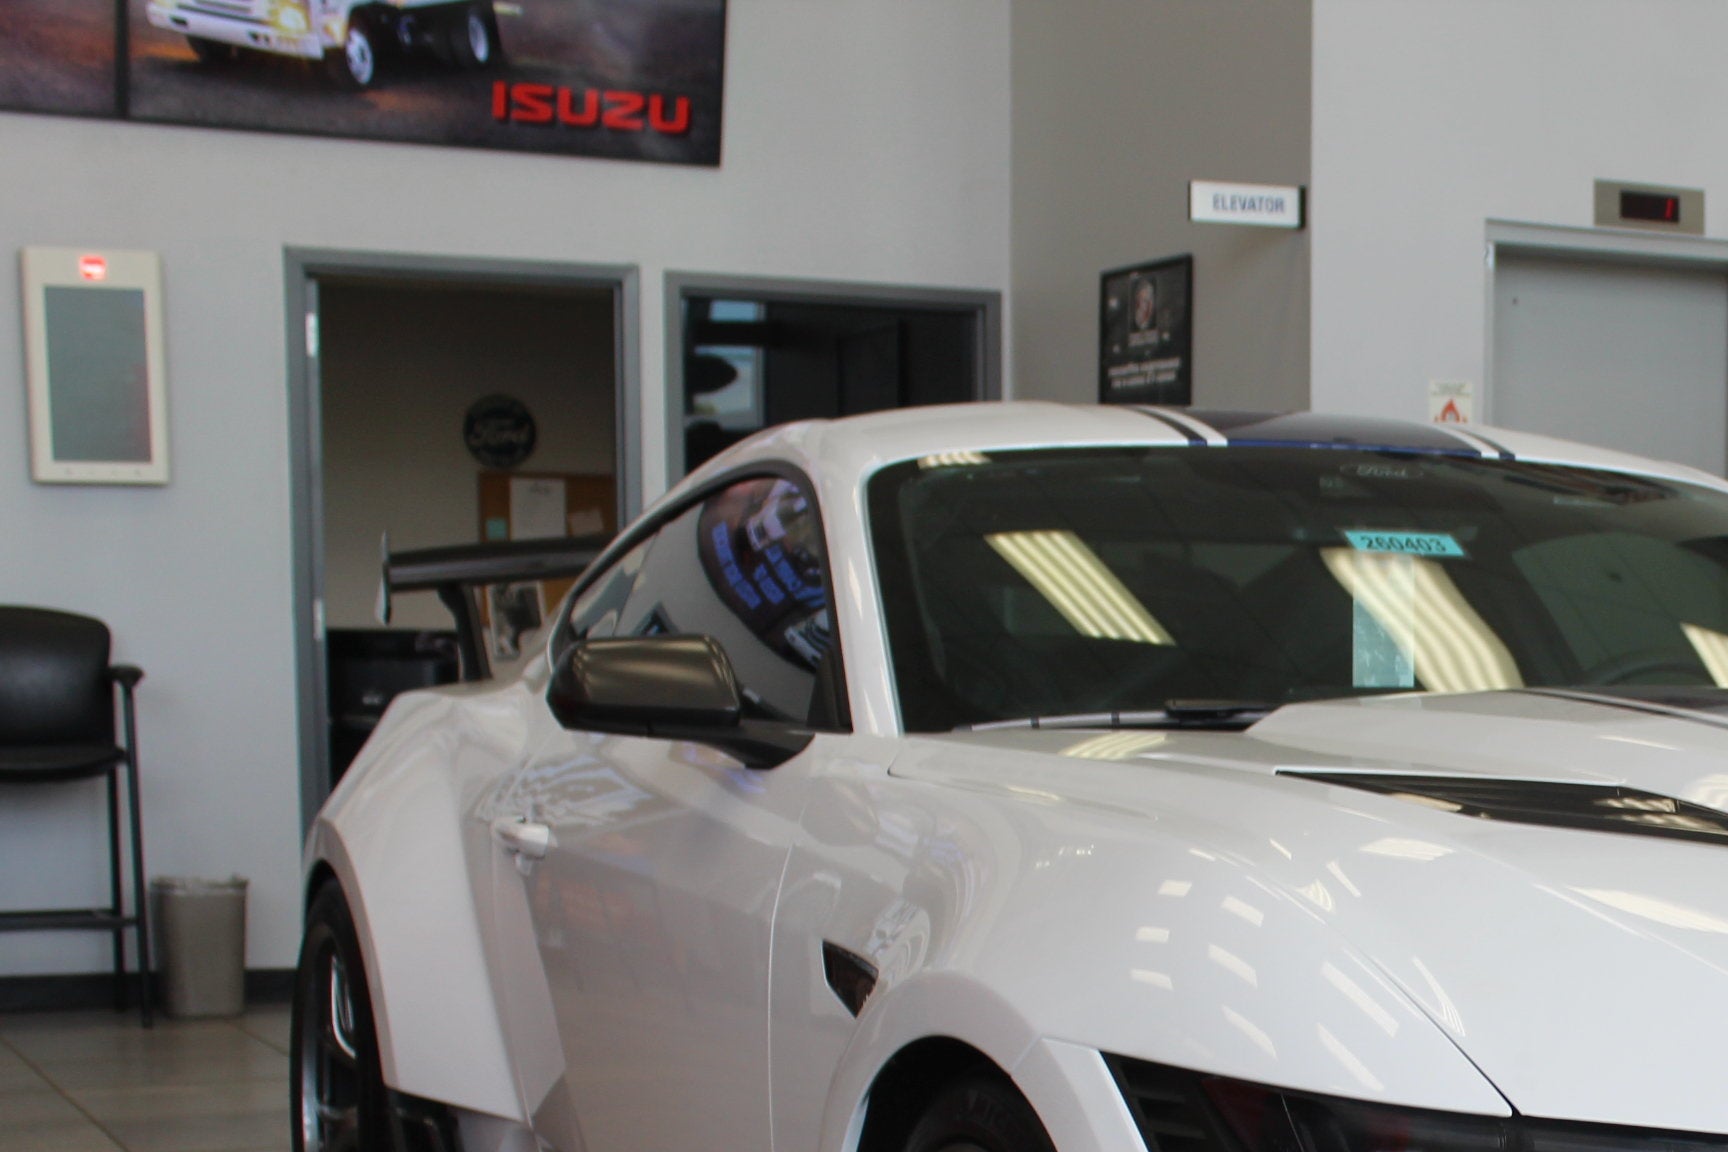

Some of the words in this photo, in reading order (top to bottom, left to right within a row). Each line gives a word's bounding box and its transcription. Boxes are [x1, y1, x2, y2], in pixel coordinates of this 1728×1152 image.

[492, 79, 690, 134] ISUZU
[1212, 193, 1285, 213] ELEVATOR
[1664, 198, 1675, 219] 1
[1360, 534, 1447, 553] 260403
